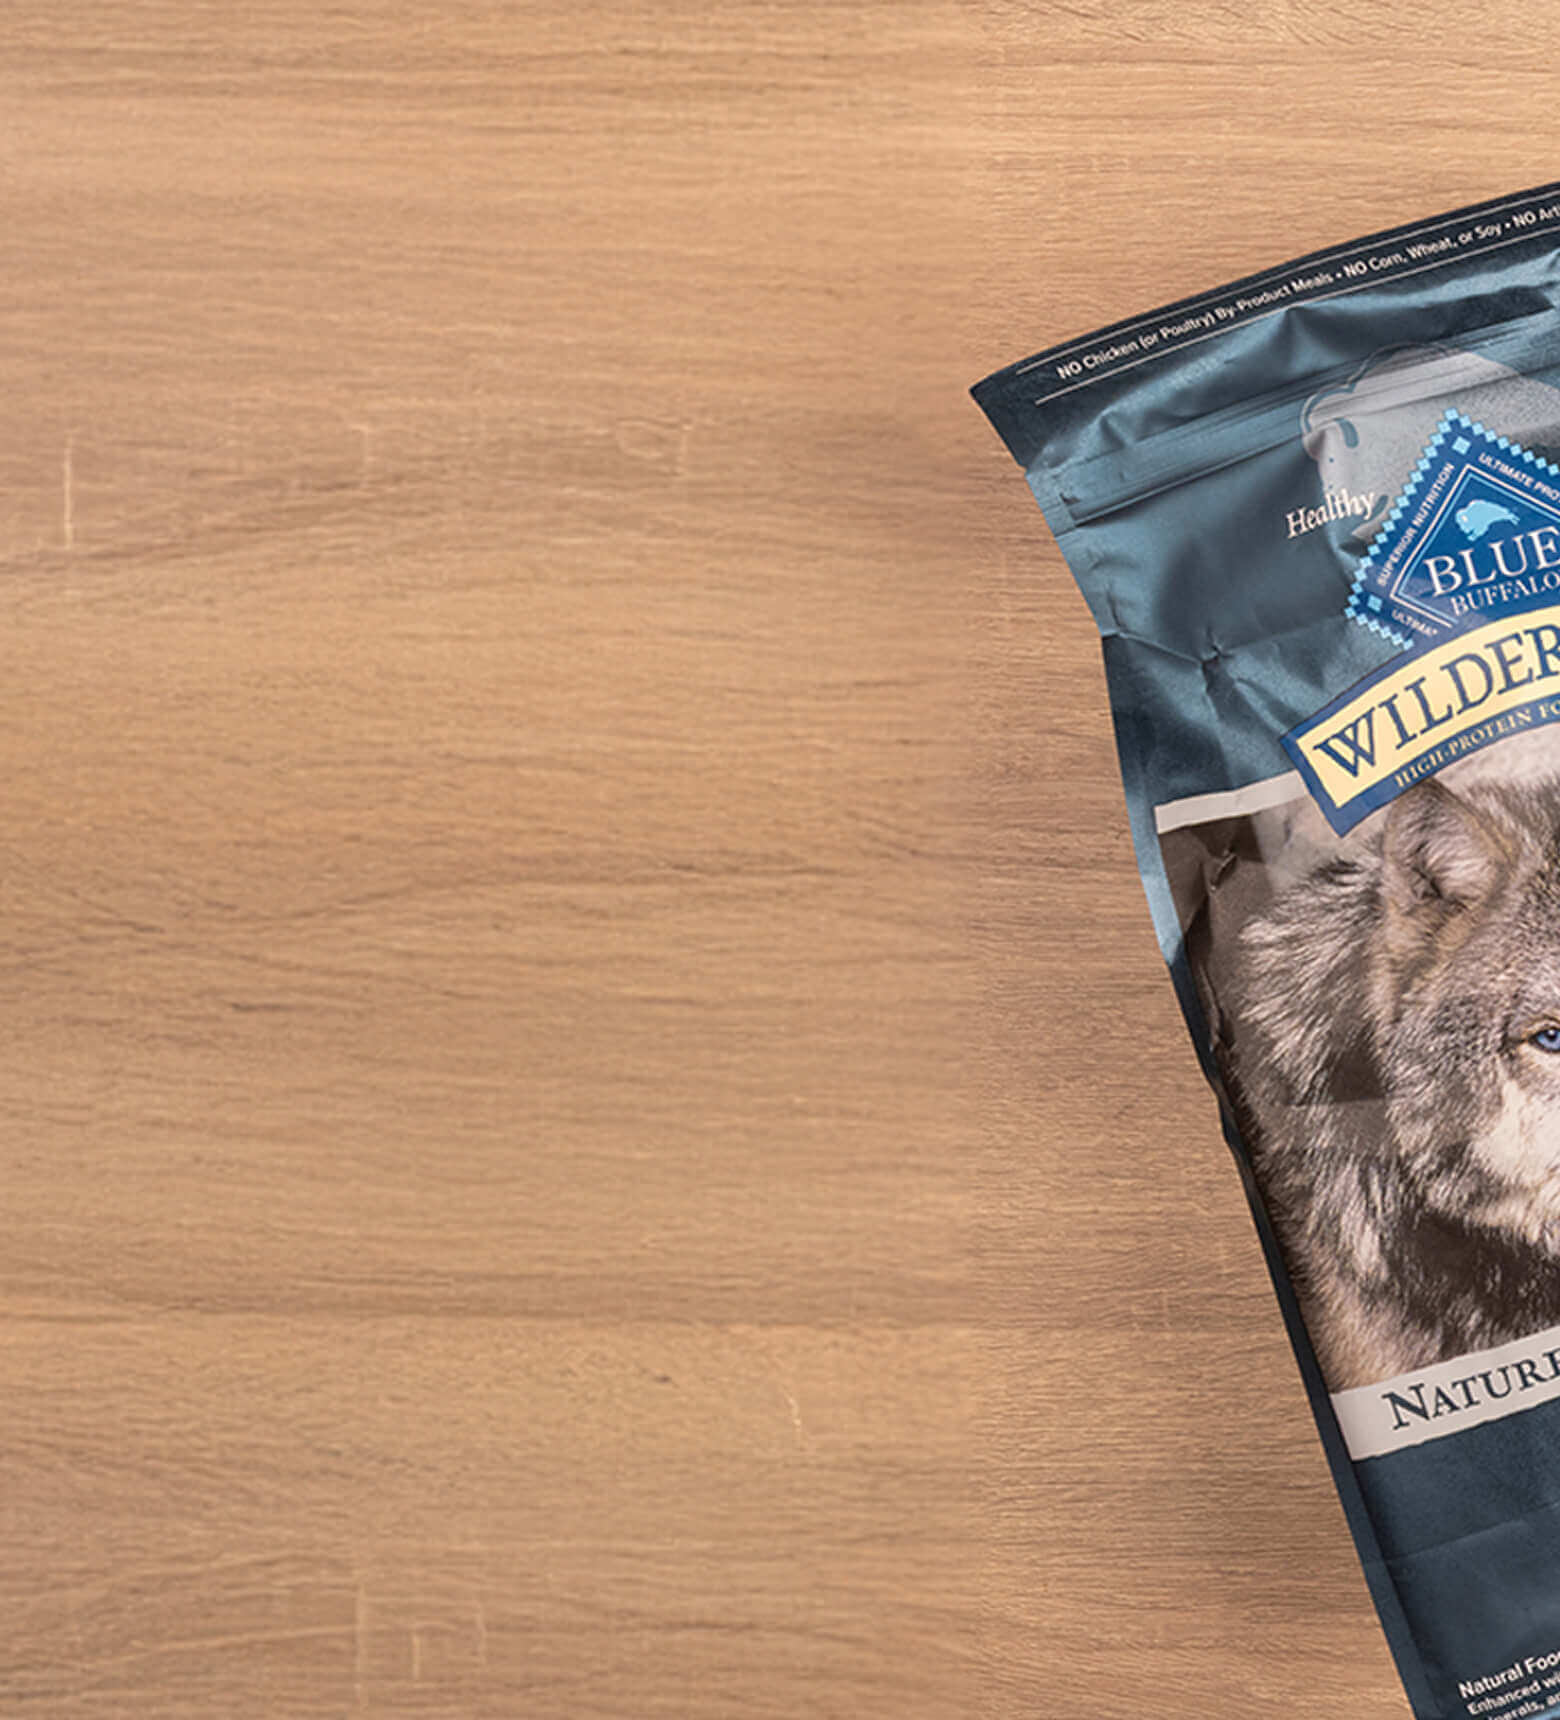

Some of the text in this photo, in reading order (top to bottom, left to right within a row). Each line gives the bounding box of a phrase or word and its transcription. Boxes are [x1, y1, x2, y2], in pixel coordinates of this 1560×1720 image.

[1057, 361, 1082, 380] NO
[1083, 338, 1139, 369] Chicken
[1139, 333, 1159, 353] (or
[1160, 312, 1216, 341] Poultry)
[1215, 284, 1291, 321] By-Product
[1291, 271, 1334, 294] Meals
[1343, 260, 1368, 279] NO
[1368, 250, 1407, 273] Corn,
[1405, 237, 1458, 261] Wheat,
[1458, 230, 1474, 246] or
[1474, 222, 1502, 242] Soy
[1512, 208, 1537, 230] NO
[1478, 452, 1534, 489] ULTIMATE
[1285, 488, 1376, 540] Healthy
[1376, 462, 1455, 587] SUPERIOR NUTRITION
[1395, 708, 1533, 787] HIGH-PROTEIN
[1457, 1662, 1524, 1699] Natural
[1466, 1680, 1541, 1716] Enhanced
